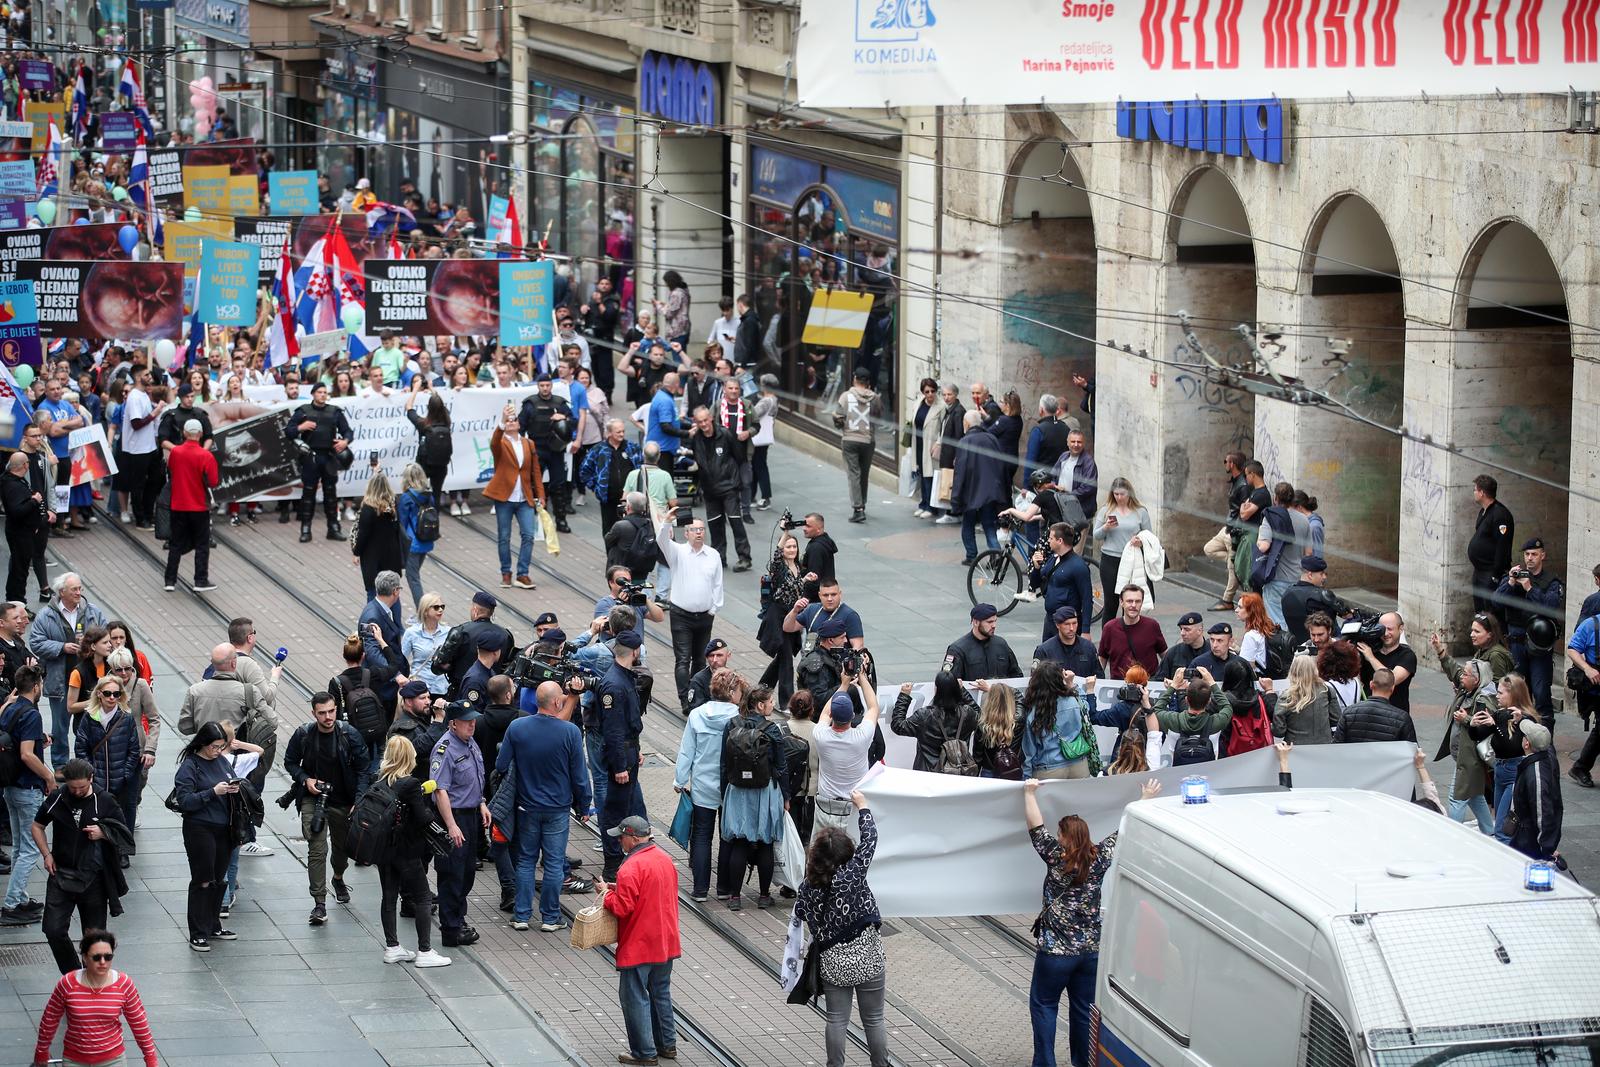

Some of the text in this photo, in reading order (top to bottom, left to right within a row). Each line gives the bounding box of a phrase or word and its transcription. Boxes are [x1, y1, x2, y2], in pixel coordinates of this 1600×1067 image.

[1062, 0, 1114, 22] Smoje
[854, 47, 937, 64] KOMEDIJA
[1060, 41, 1113, 57] redateljica
[1023, 58, 1115, 74] Marina Pejnović
[641, 49, 715, 128] nama
[150, 152, 178, 165] OVAKO
[157, 173, 182, 185] DESET
[7, 234, 41, 248] OVAKO
[40, 267, 80, 280] OVAKO
[218, 263, 243, 272] LIVES
[388, 266, 426, 279] OVAKO
[6, 283, 29, 295] IZBOR
[371, 280, 426, 293] IZGLEDAM
[221, 288, 239, 300] TOO
[382, 294, 427, 306] S DESET
[44, 295, 79, 308] DESET
[379, 307, 427, 320] TJEDANA
[10, 326, 37, 338] DIJETE
[343, 405, 363, 420] Ne
[460, 415, 496, 433] srca!
